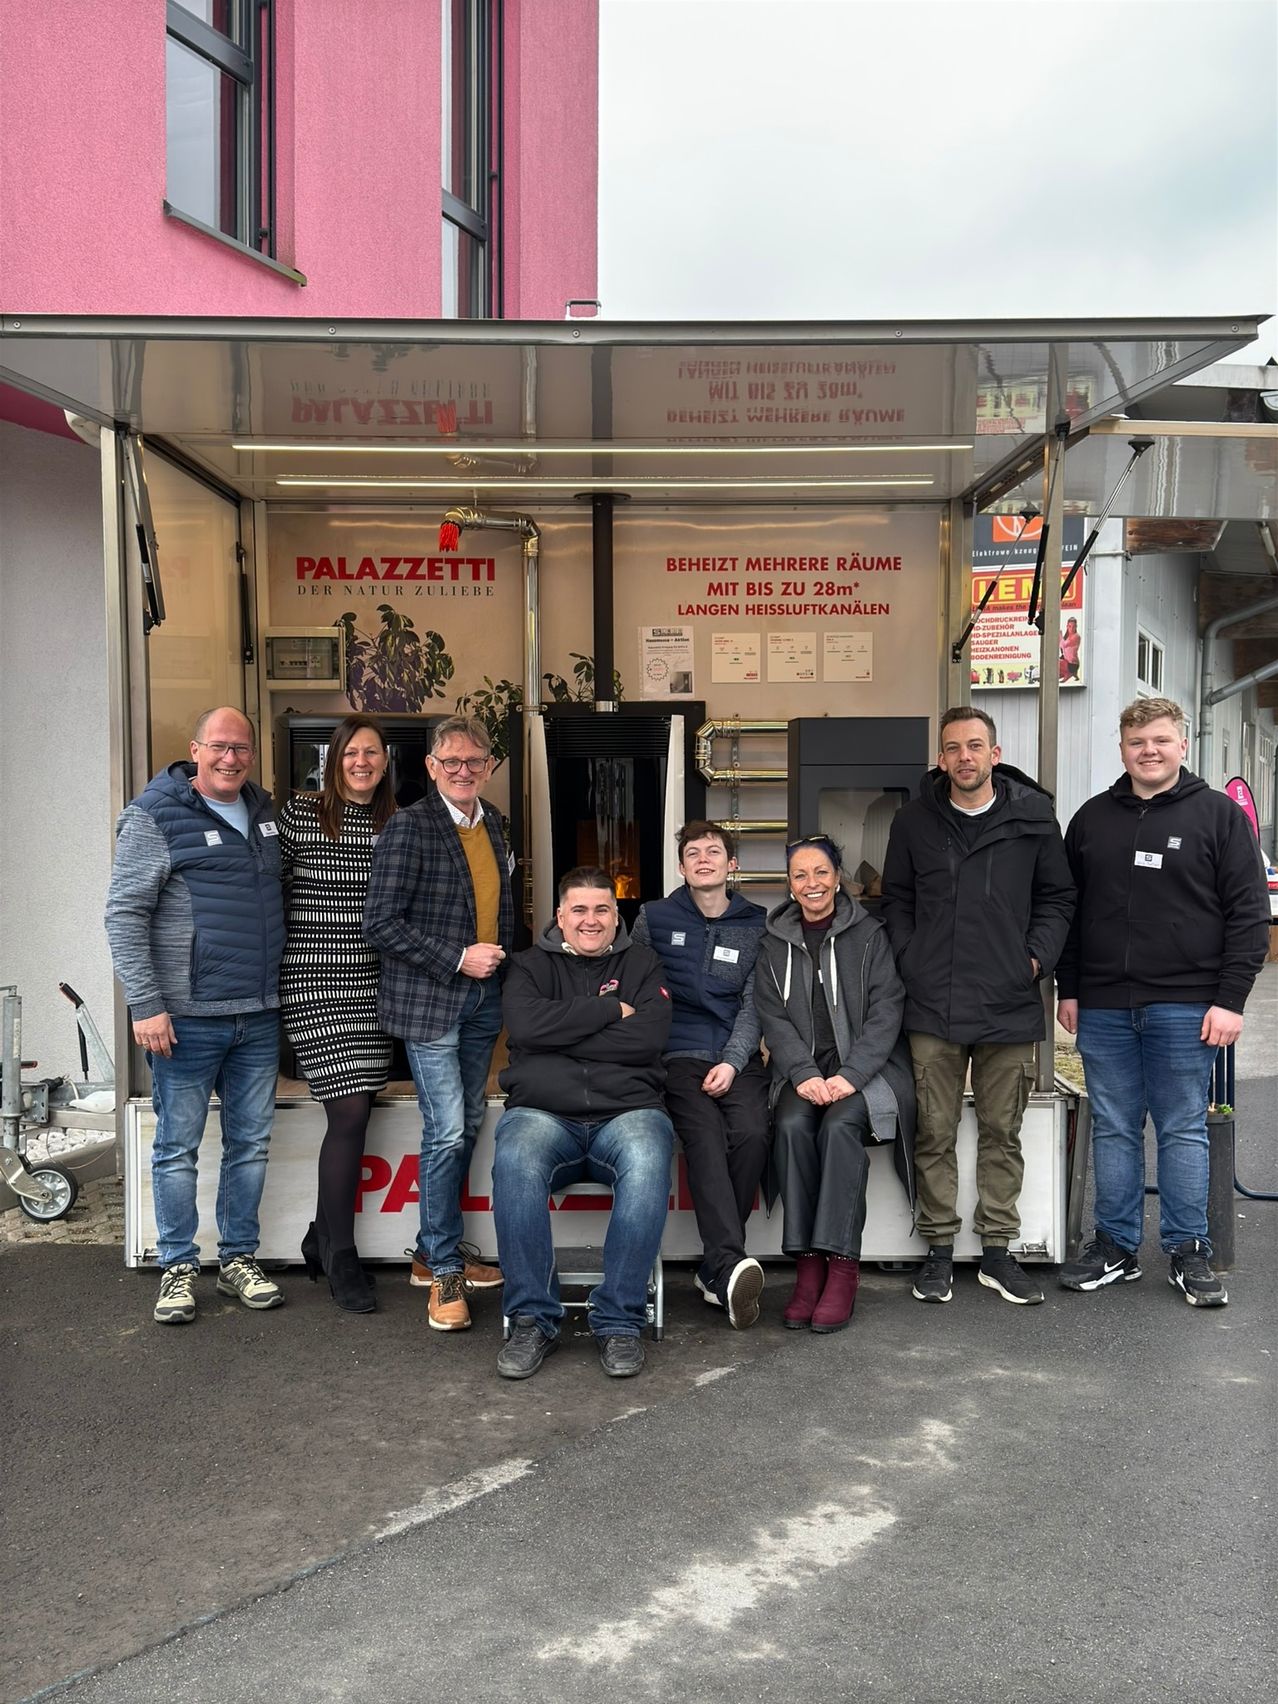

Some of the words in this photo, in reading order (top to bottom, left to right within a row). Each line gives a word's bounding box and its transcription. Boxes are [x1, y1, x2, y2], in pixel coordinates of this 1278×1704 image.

[296, 556, 496, 581] PALAZZETTI
[666, 557, 739, 572] BEHEIZT
[745, 557, 829, 571] MEHRERE
[836, 552, 902, 571] RÄUME
[298, 585, 332, 596] DER
[344, 585, 404, 596] NATUR
[415, 585, 495, 596] ZULIEBE
[707, 582, 739, 596] MIT
[746, 582, 773, 596] BIS
[781, 582, 806, 596] ZU
[678, 604, 739, 615] LANGEN
[745, 600, 890, 616] HEISSLUFTKANÄLEN
